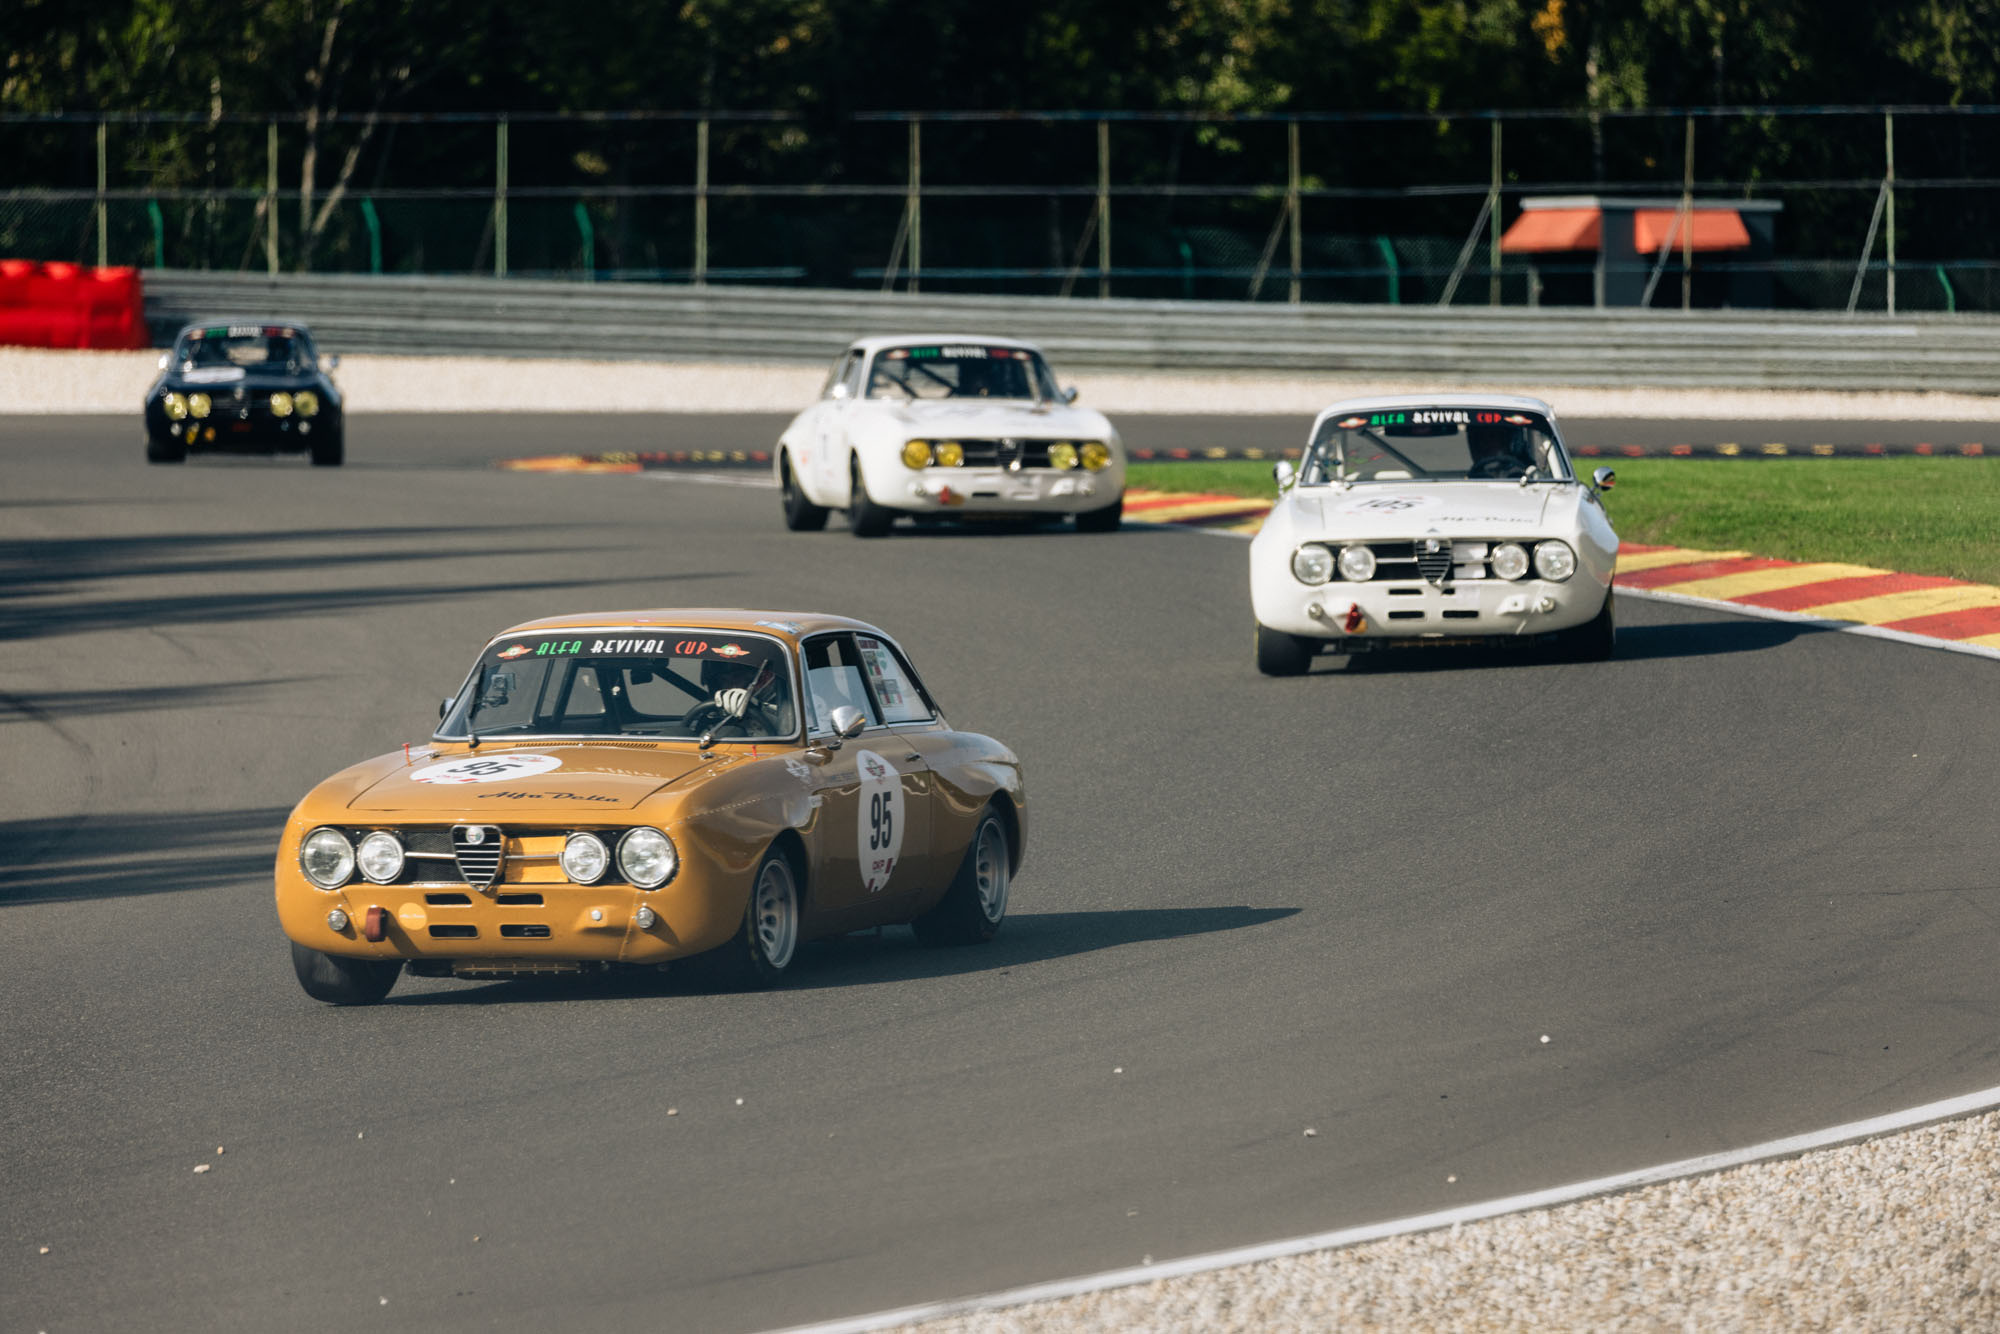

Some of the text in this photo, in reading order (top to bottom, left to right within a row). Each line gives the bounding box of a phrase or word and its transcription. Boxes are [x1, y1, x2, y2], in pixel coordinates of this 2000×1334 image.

[1370, 411, 1502, 426] ALFA REVIVAL CUP
[535, 639, 708, 656] ALFA REVIVAL CUP
[447, 761, 524, 776] 95
[477, 791, 620, 803] Alfa Delta
[870, 791, 892, 850] 95
